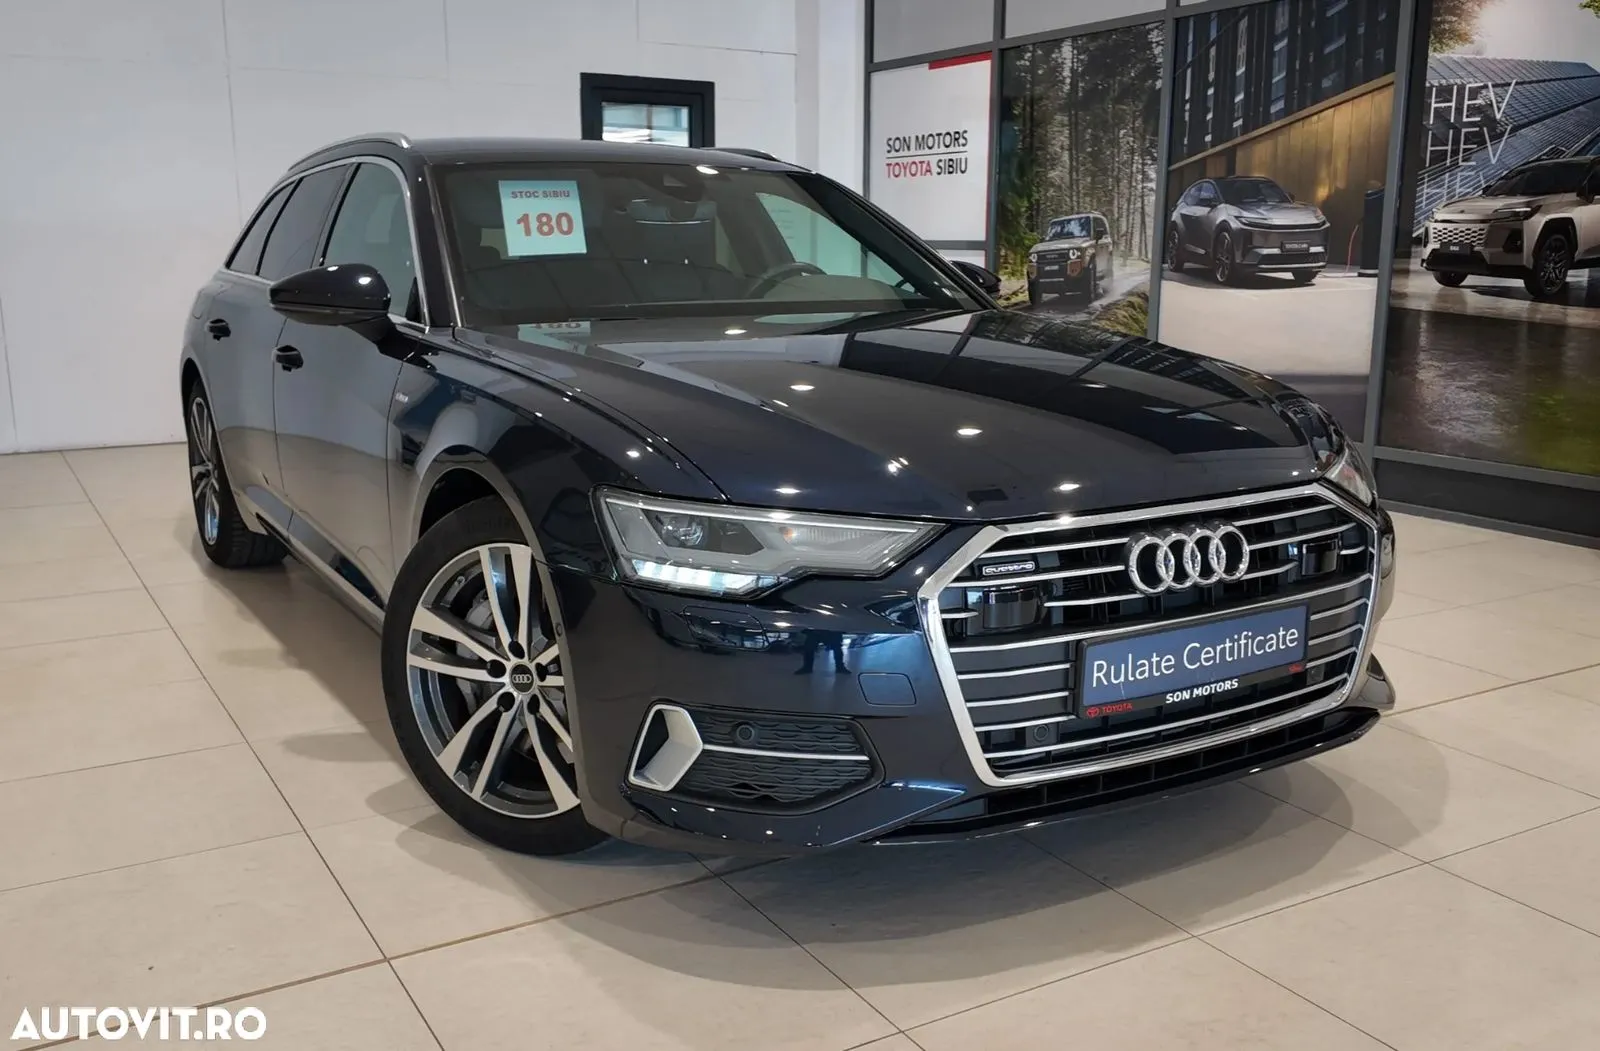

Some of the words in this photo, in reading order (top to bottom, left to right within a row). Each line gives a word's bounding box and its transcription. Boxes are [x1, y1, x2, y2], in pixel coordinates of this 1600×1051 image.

[1430, 79, 1518, 124] HEV
[886, 136, 912, 154] SON
[914, 129, 968, 151] MOTORS
[1425, 124, 1513, 168] HEV
[886, 160, 933, 178] TOYOTA
[936, 157, 968, 175] SIBIU
[511, 190, 540, 199] STOC
[541, 190, 571, 199] SIBIU
[1422, 171, 1486, 209] HE
[516, 212, 574, 237] 180
[1092, 652, 1175, 688] Rulate
[1182, 626, 1299, 670] Certificate
[1165, 690, 1191, 704] SON
[1194, 678, 1239, 697] MOTORS
[1101, 703, 1133, 714] TOYOTA
